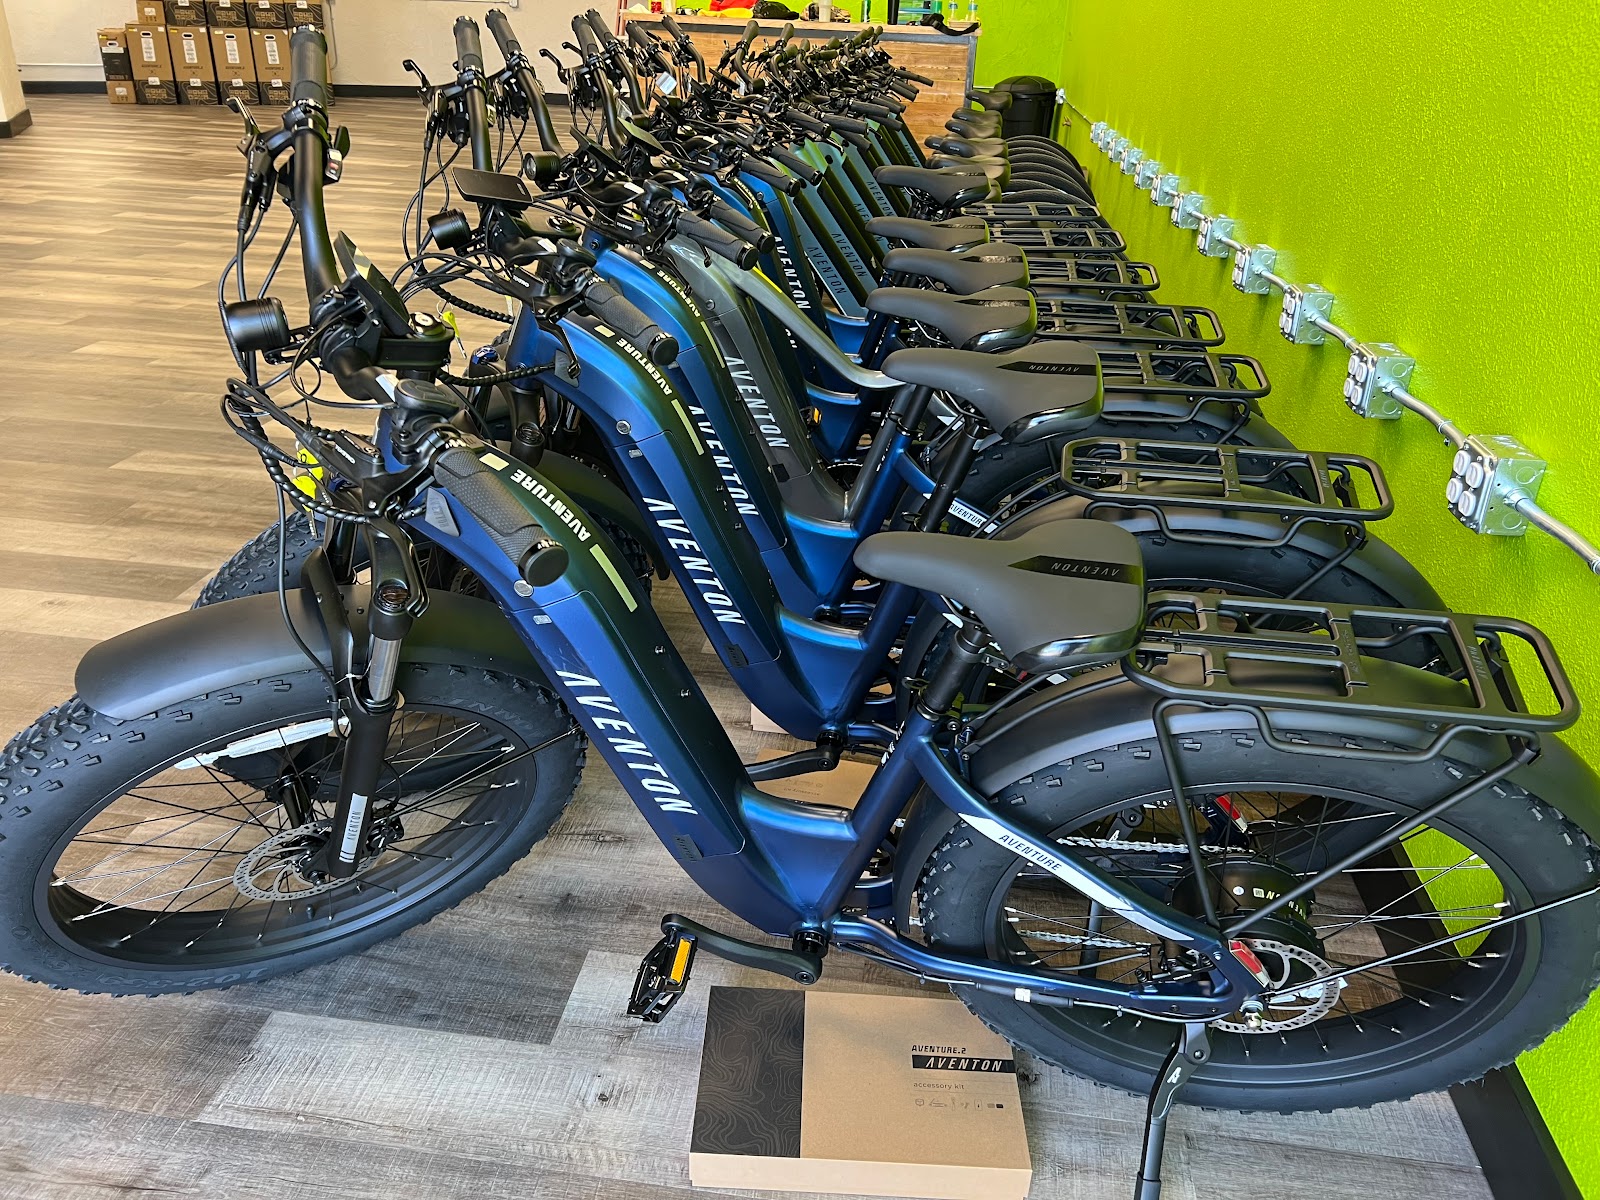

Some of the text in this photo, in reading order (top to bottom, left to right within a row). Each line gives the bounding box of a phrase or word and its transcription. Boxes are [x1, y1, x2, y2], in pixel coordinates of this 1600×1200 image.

[866, 181, 894, 217] AVENTON
[774, 236, 811, 309] AVENTON
[807, 246, 847, 295] AVENTON
[831, 233, 868, 277] AVENTON
[656, 270, 701, 317] AVENTURE
[616, 337, 673, 396] AVENTURE
[1028, 364, 1080, 373] AVENTON
[724, 356, 790, 448] AVENTON
[688, 405, 759, 516] AVENTON
[510, 469, 592, 542] AVENTURE
[642, 497, 746, 625] AVENTON
[1050, 562, 1120, 577] AVENTON
[555, 670, 699, 815] AVENTON
[346, 810, 362, 841] AVENTON
[998, 834, 1062, 871] AVENTURE
[911, 1044, 967, 1055] AVENTURE.2
[925, 1056, 1003, 1072] AVENTON
[913, 1082, 952, 1090] accessory
